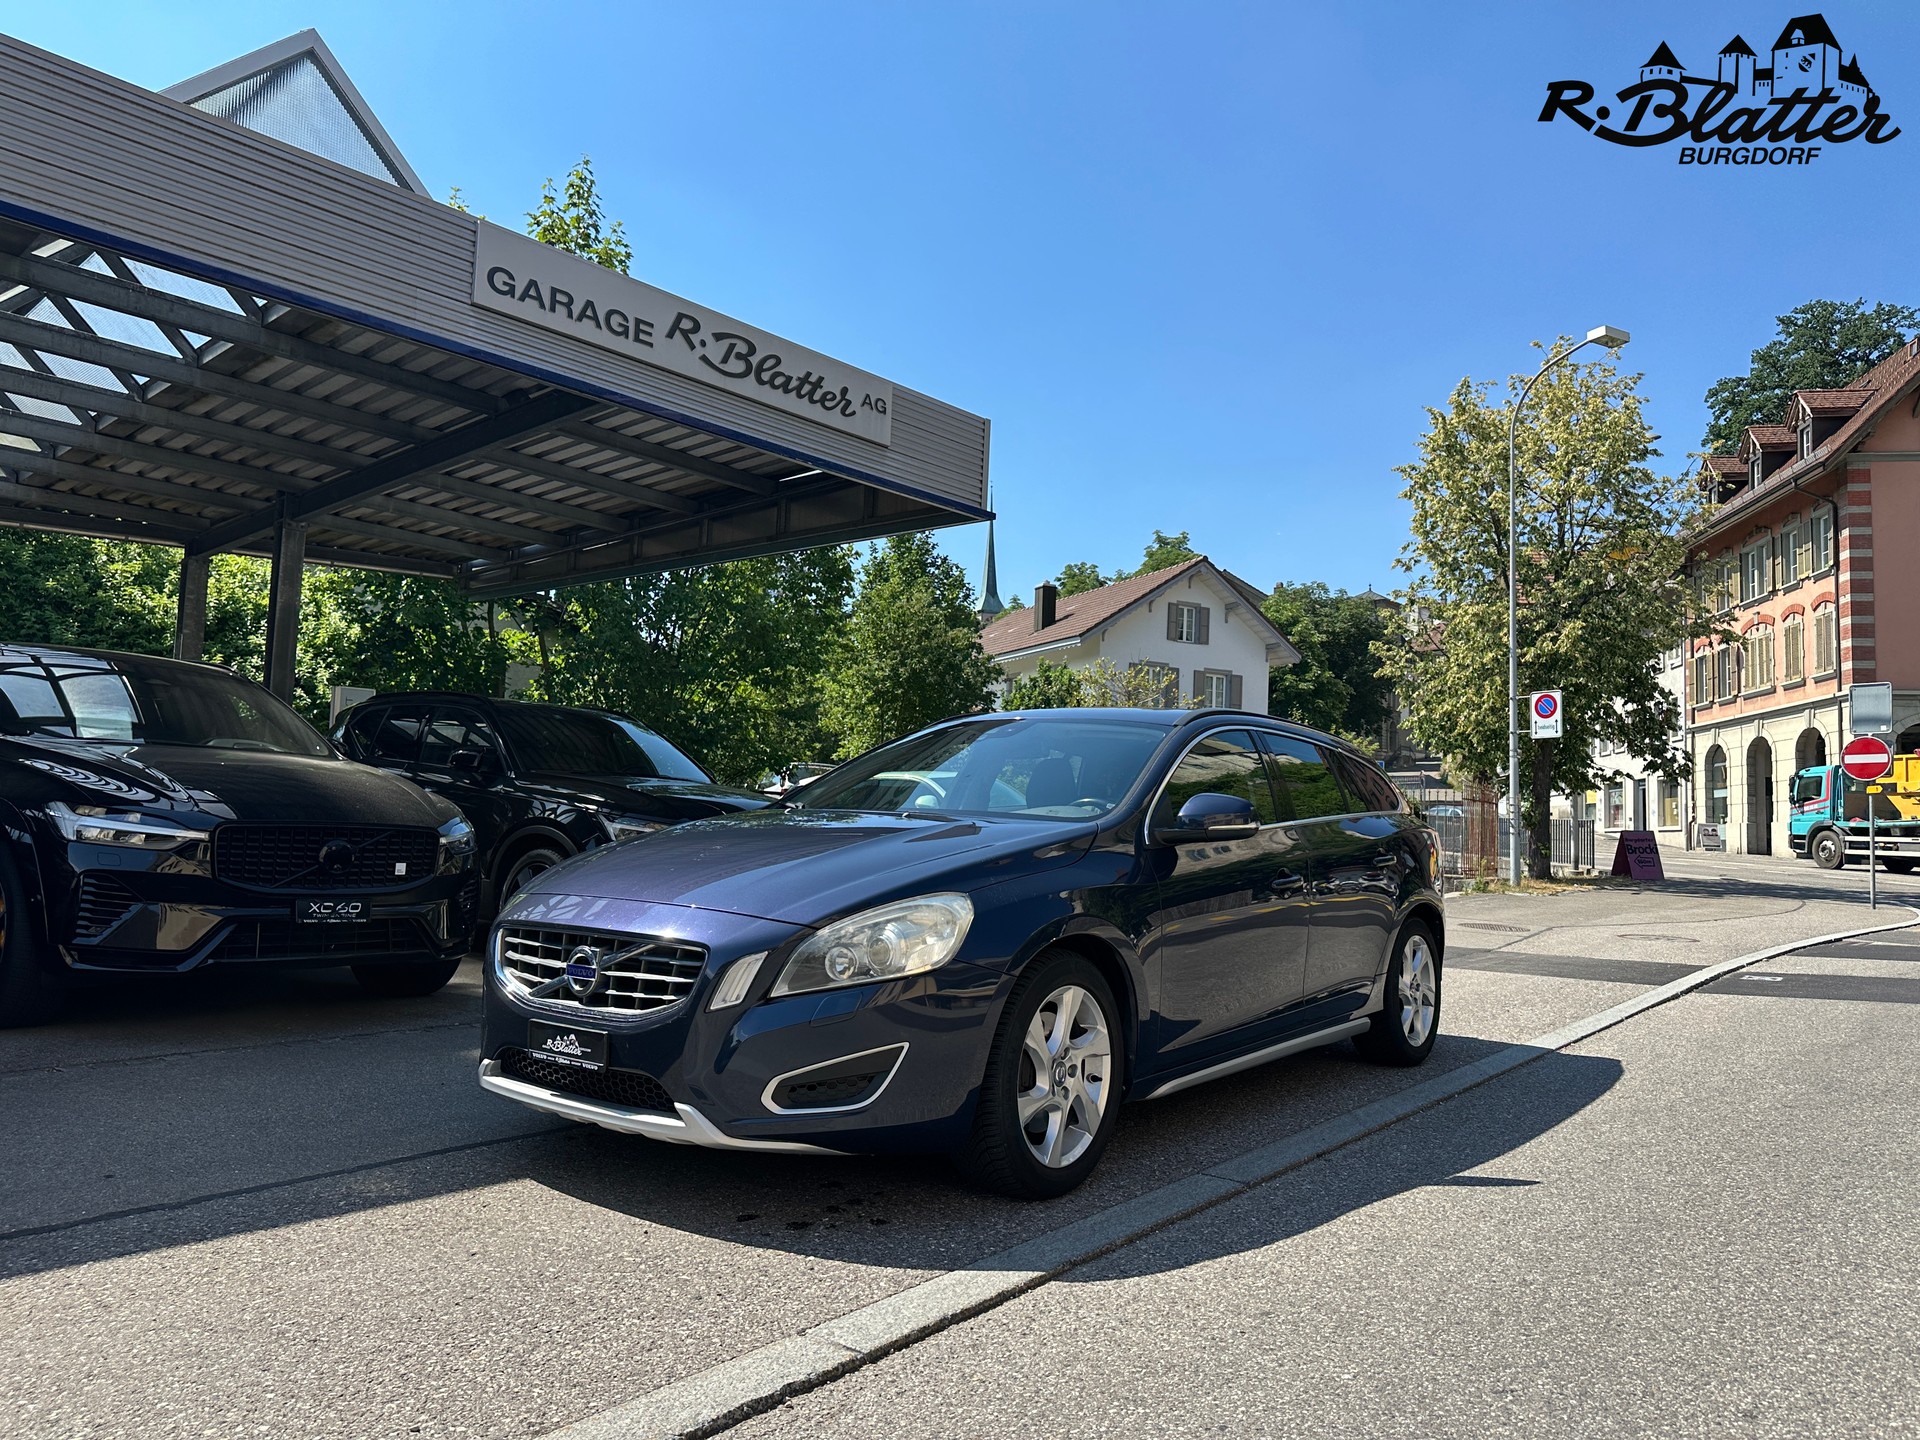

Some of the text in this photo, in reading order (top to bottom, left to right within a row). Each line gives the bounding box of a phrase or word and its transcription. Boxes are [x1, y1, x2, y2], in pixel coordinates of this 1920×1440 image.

[486, 266, 655, 349] GARAGE
[860, 393, 887, 416] AG
[1625, 843, 1659, 855] Brocki
[568, 967, 594, 976] VOLVO
